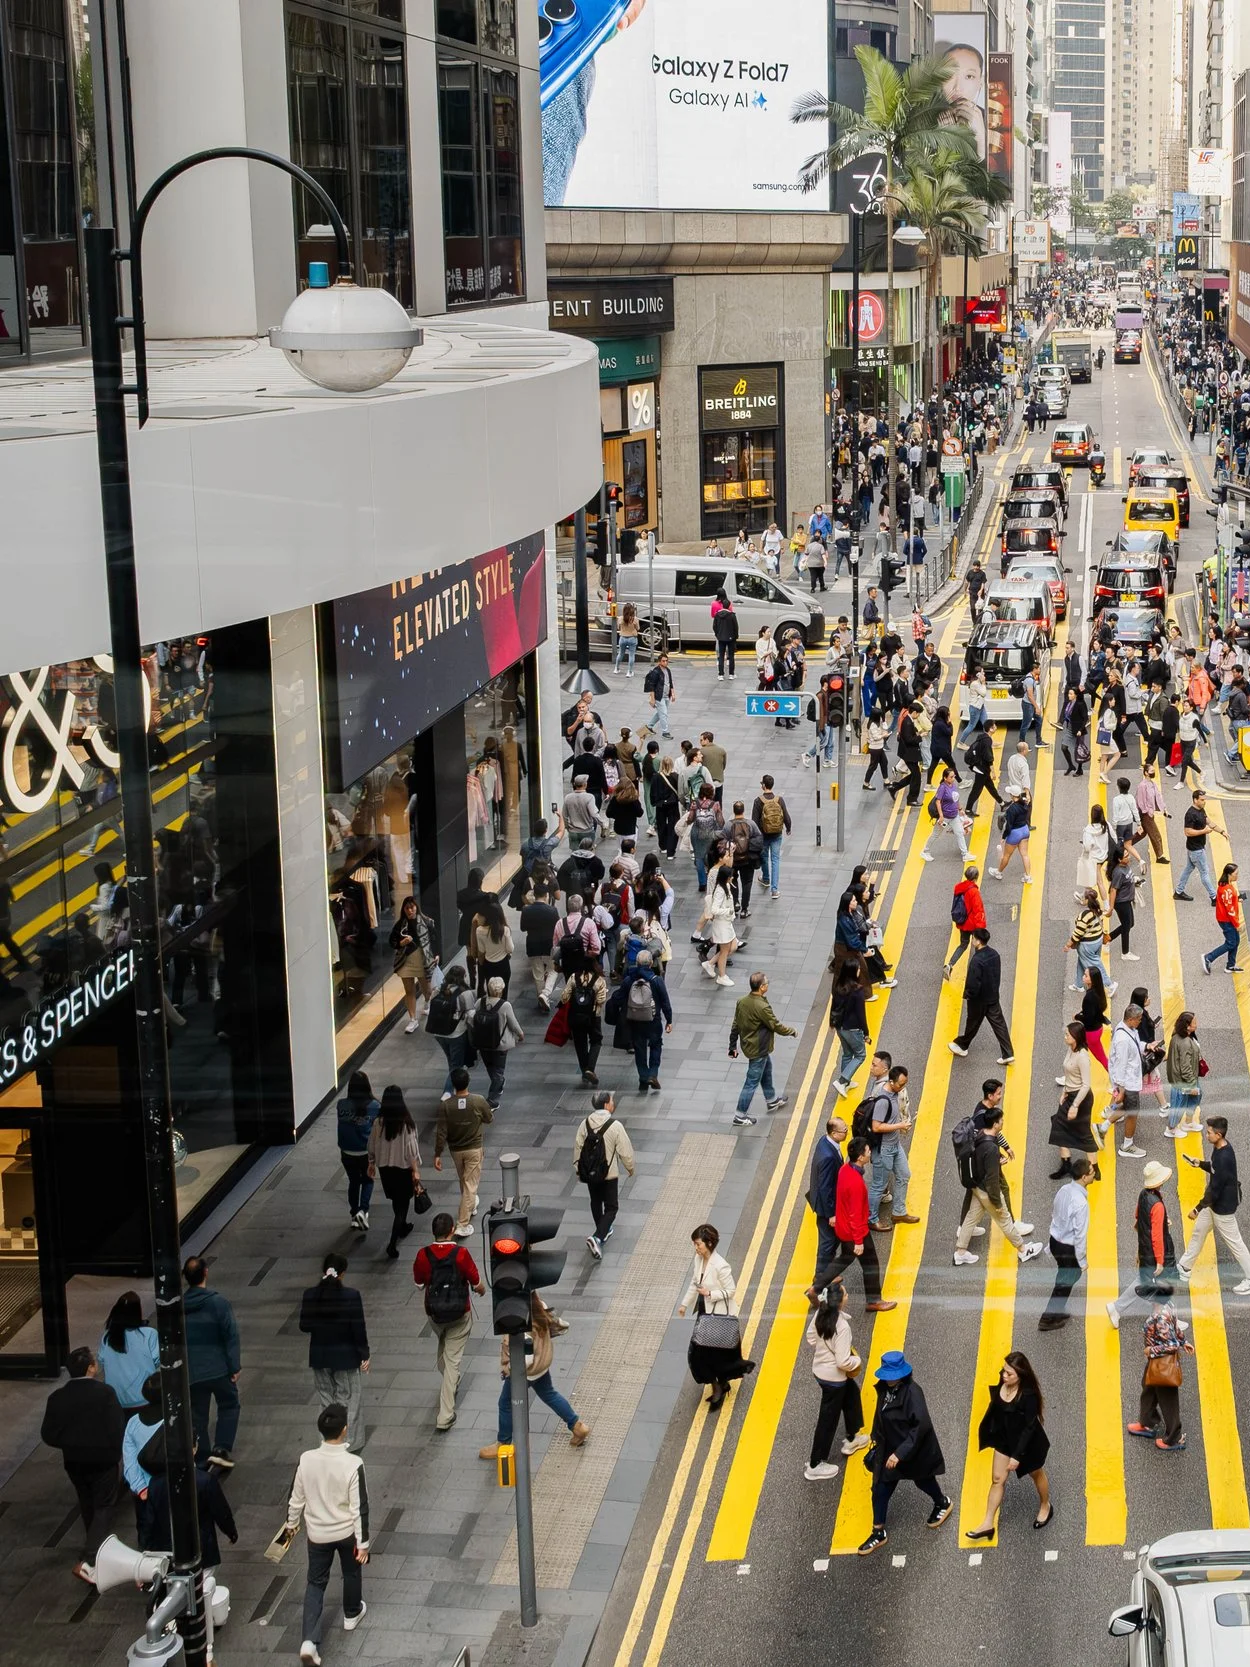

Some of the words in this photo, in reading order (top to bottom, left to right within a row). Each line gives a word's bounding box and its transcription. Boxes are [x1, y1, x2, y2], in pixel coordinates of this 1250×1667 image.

[652, 54, 719, 83] Galaxy
[723, 60, 734, 79] Z
[739, 61, 789, 82] Fold7
[669, 88, 730, 112] Galaxy
[733, 92, 749, 108] AI
[752, 182, 818, 193] samsung.comhk
[551, 299, 592, 317] ENT
[602, 296, 664, 315] BUILDING
[857, 348, 890, 360] 恒生銀
[705, 395, 777, 411] BREITLING
[730, 410, 752, 420] 1884
[392, 579, 470, 661] ELEVATED
[475, 553, 515, 611] STYLE
[0, 1038, 18, 1084] S
[22, 1025, 38, 1063] &
